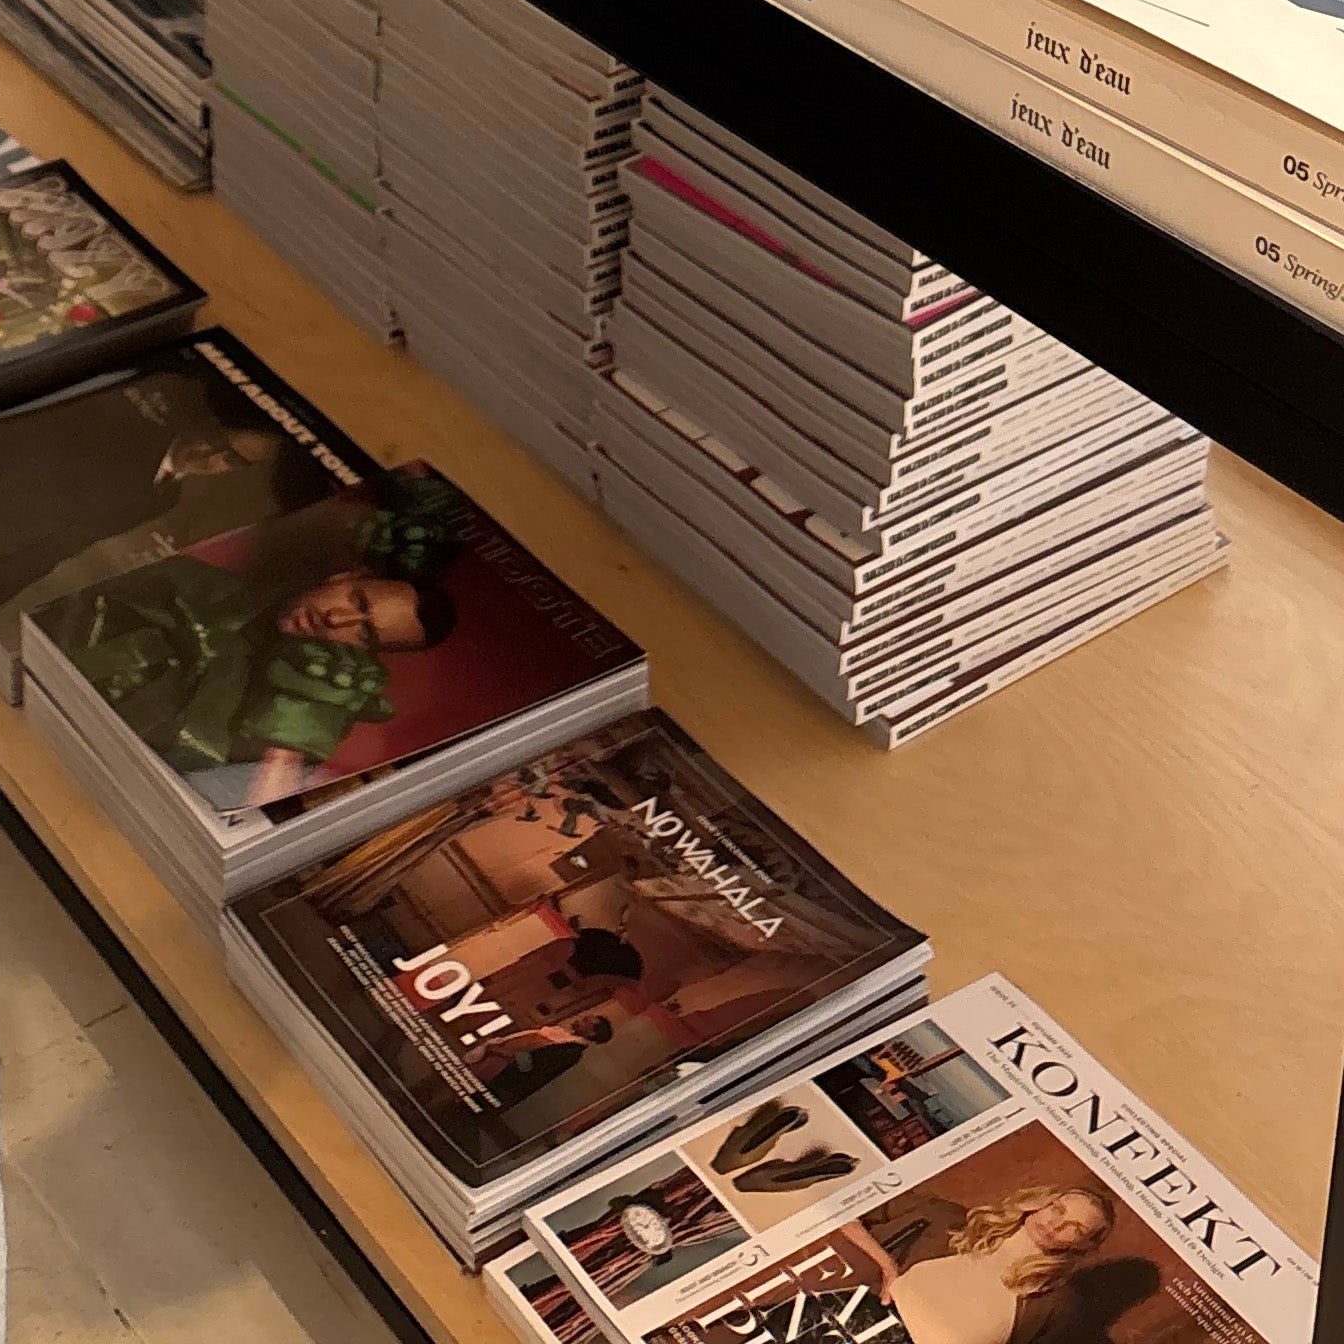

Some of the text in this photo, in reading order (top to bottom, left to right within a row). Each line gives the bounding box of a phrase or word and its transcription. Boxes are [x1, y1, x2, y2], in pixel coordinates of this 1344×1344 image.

[1025, 22, 1071, 66] jeux
[1010, 93, 1053, 138] jeux
[1283, 155, 1309, 182] 05
[1255, 235, 1344, 301] 05 Spring/
[194, 341, 364, 486] MAN ABOUT TOW
[391, 943, 514, 1046] JOY!
[987, 1021, 1282, 1281] KONFEKT
